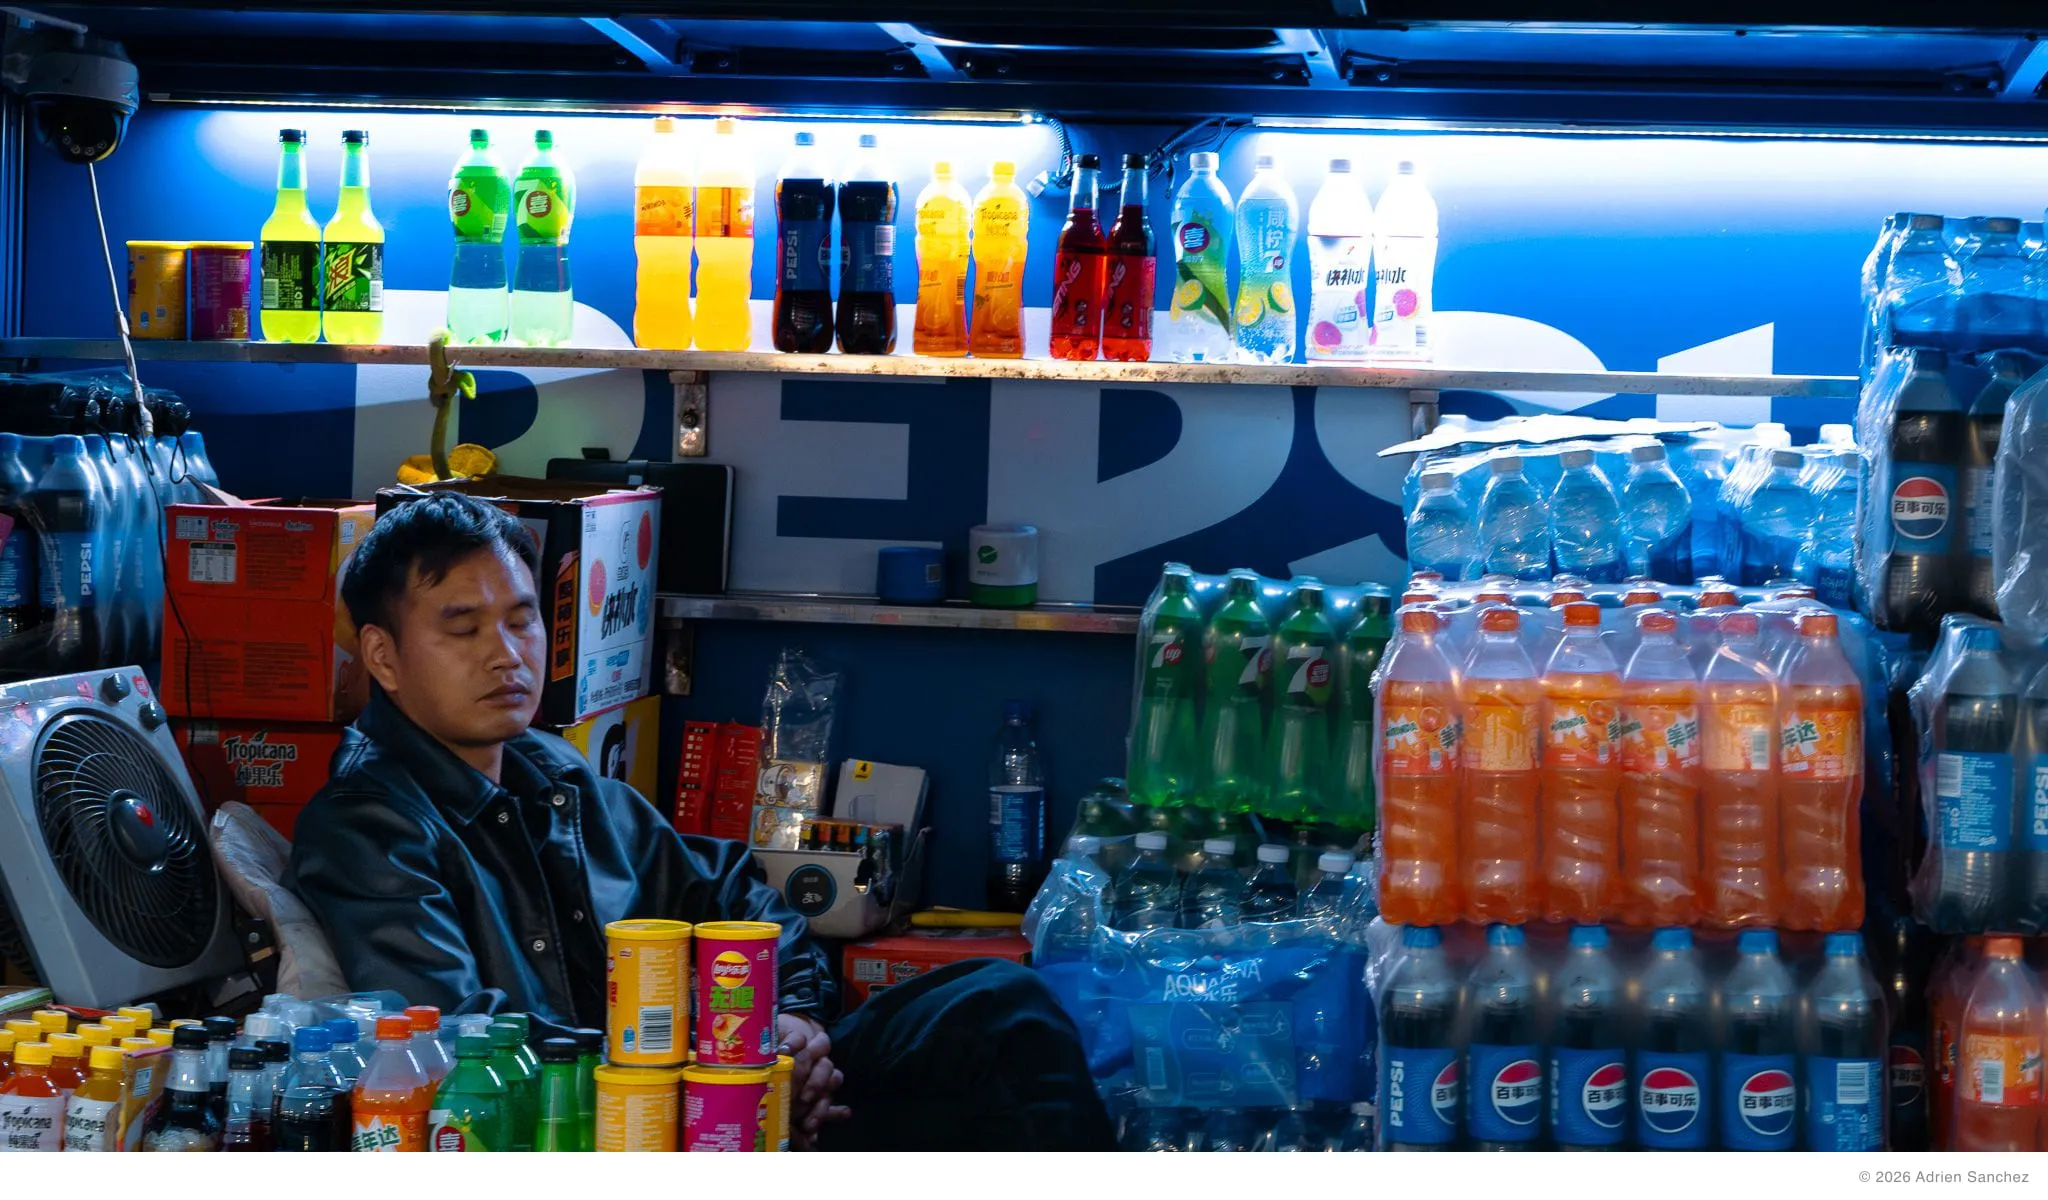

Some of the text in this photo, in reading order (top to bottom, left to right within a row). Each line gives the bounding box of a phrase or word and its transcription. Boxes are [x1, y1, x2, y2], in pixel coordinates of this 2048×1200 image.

[786, 230, 798, 280] PEPSI
[1894, 500, 1948, 515] 百事可乐
[81, 543, 92, 596] PEPSI
[223, 730, 298, 763] Tropicana
[1390, 1060, 1404, 1127] PEPSI
[1642, 1090, 1696, 1107] 百事可乐
